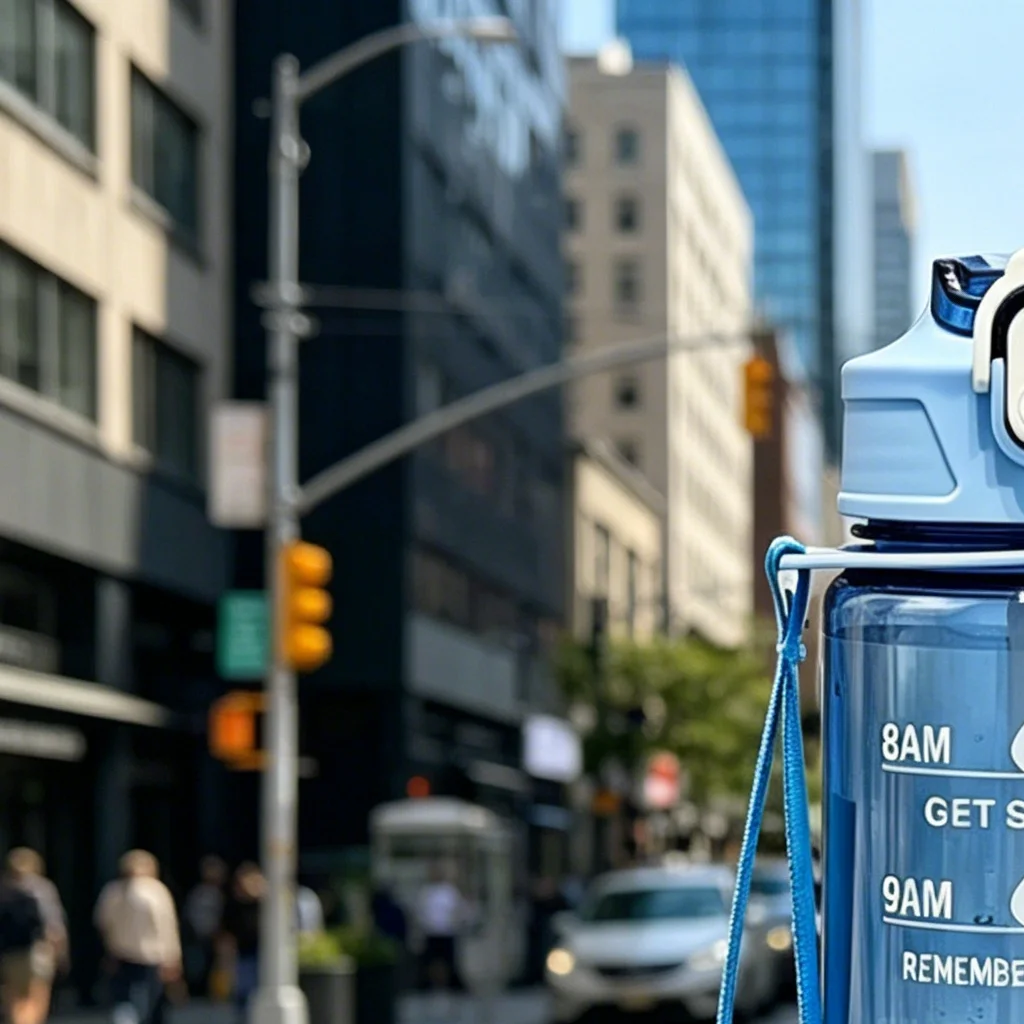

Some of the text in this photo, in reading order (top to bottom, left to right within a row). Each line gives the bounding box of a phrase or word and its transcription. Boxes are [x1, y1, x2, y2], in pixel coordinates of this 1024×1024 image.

[883, 723, 950, 764] 8AM
[924, 797, 996, 828] GET
[883, 876, 952, 919] 9AM
